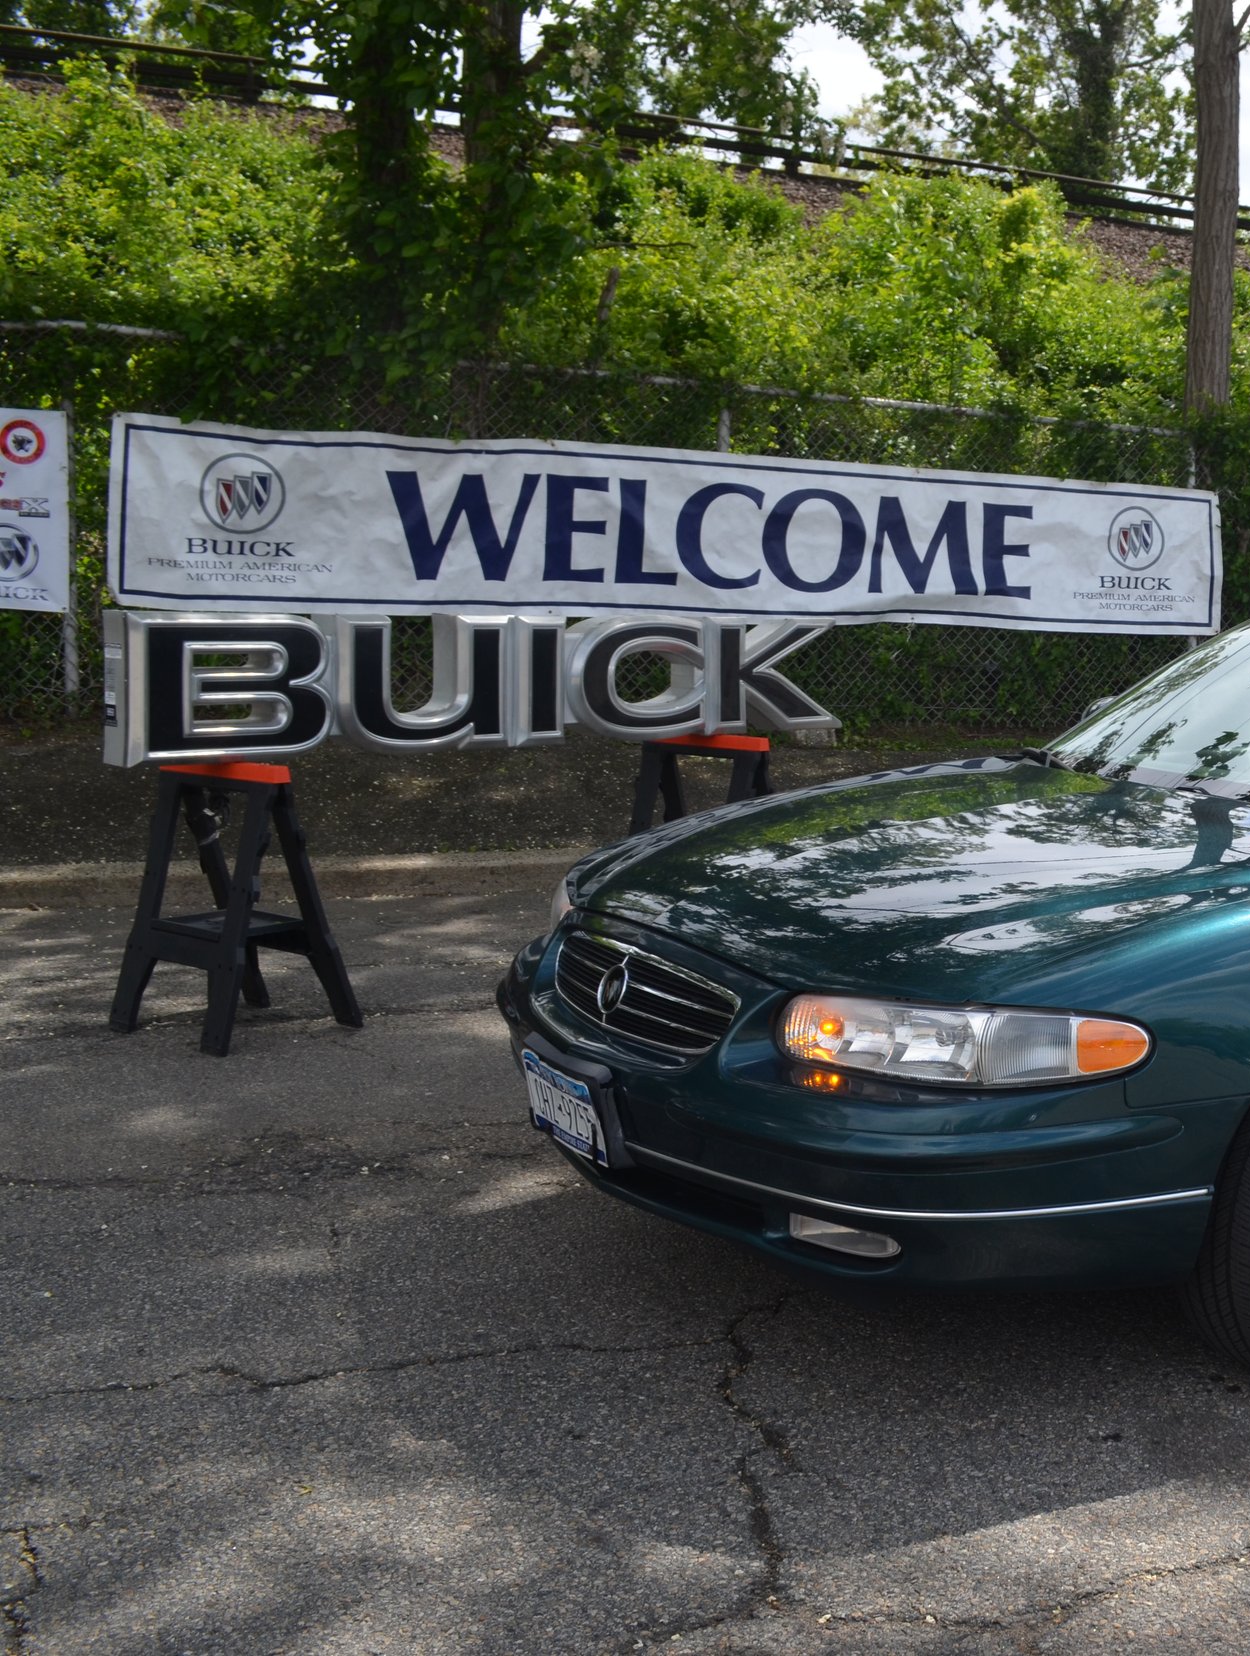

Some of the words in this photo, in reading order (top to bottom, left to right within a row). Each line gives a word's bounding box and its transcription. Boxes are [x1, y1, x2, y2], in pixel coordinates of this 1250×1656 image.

[386, 471, 1033, 600] WELCOME
[185, 537, 296, 557] BUICK
[147, 557, 233, 570] PREMIUM
[240, 561, 334, 573] AMERICAN
[186, 572, 297, 584] MOTORCARS
[1098, 575, 1172, 591] BUICK
[1073, 591, 1131, 601] PREMIUM
[1134, 593, 1195, 603] AMERICAN
[1098, 602, 1174, 612] MOTORCARS
[103, 611, 842, 768] BUICK
